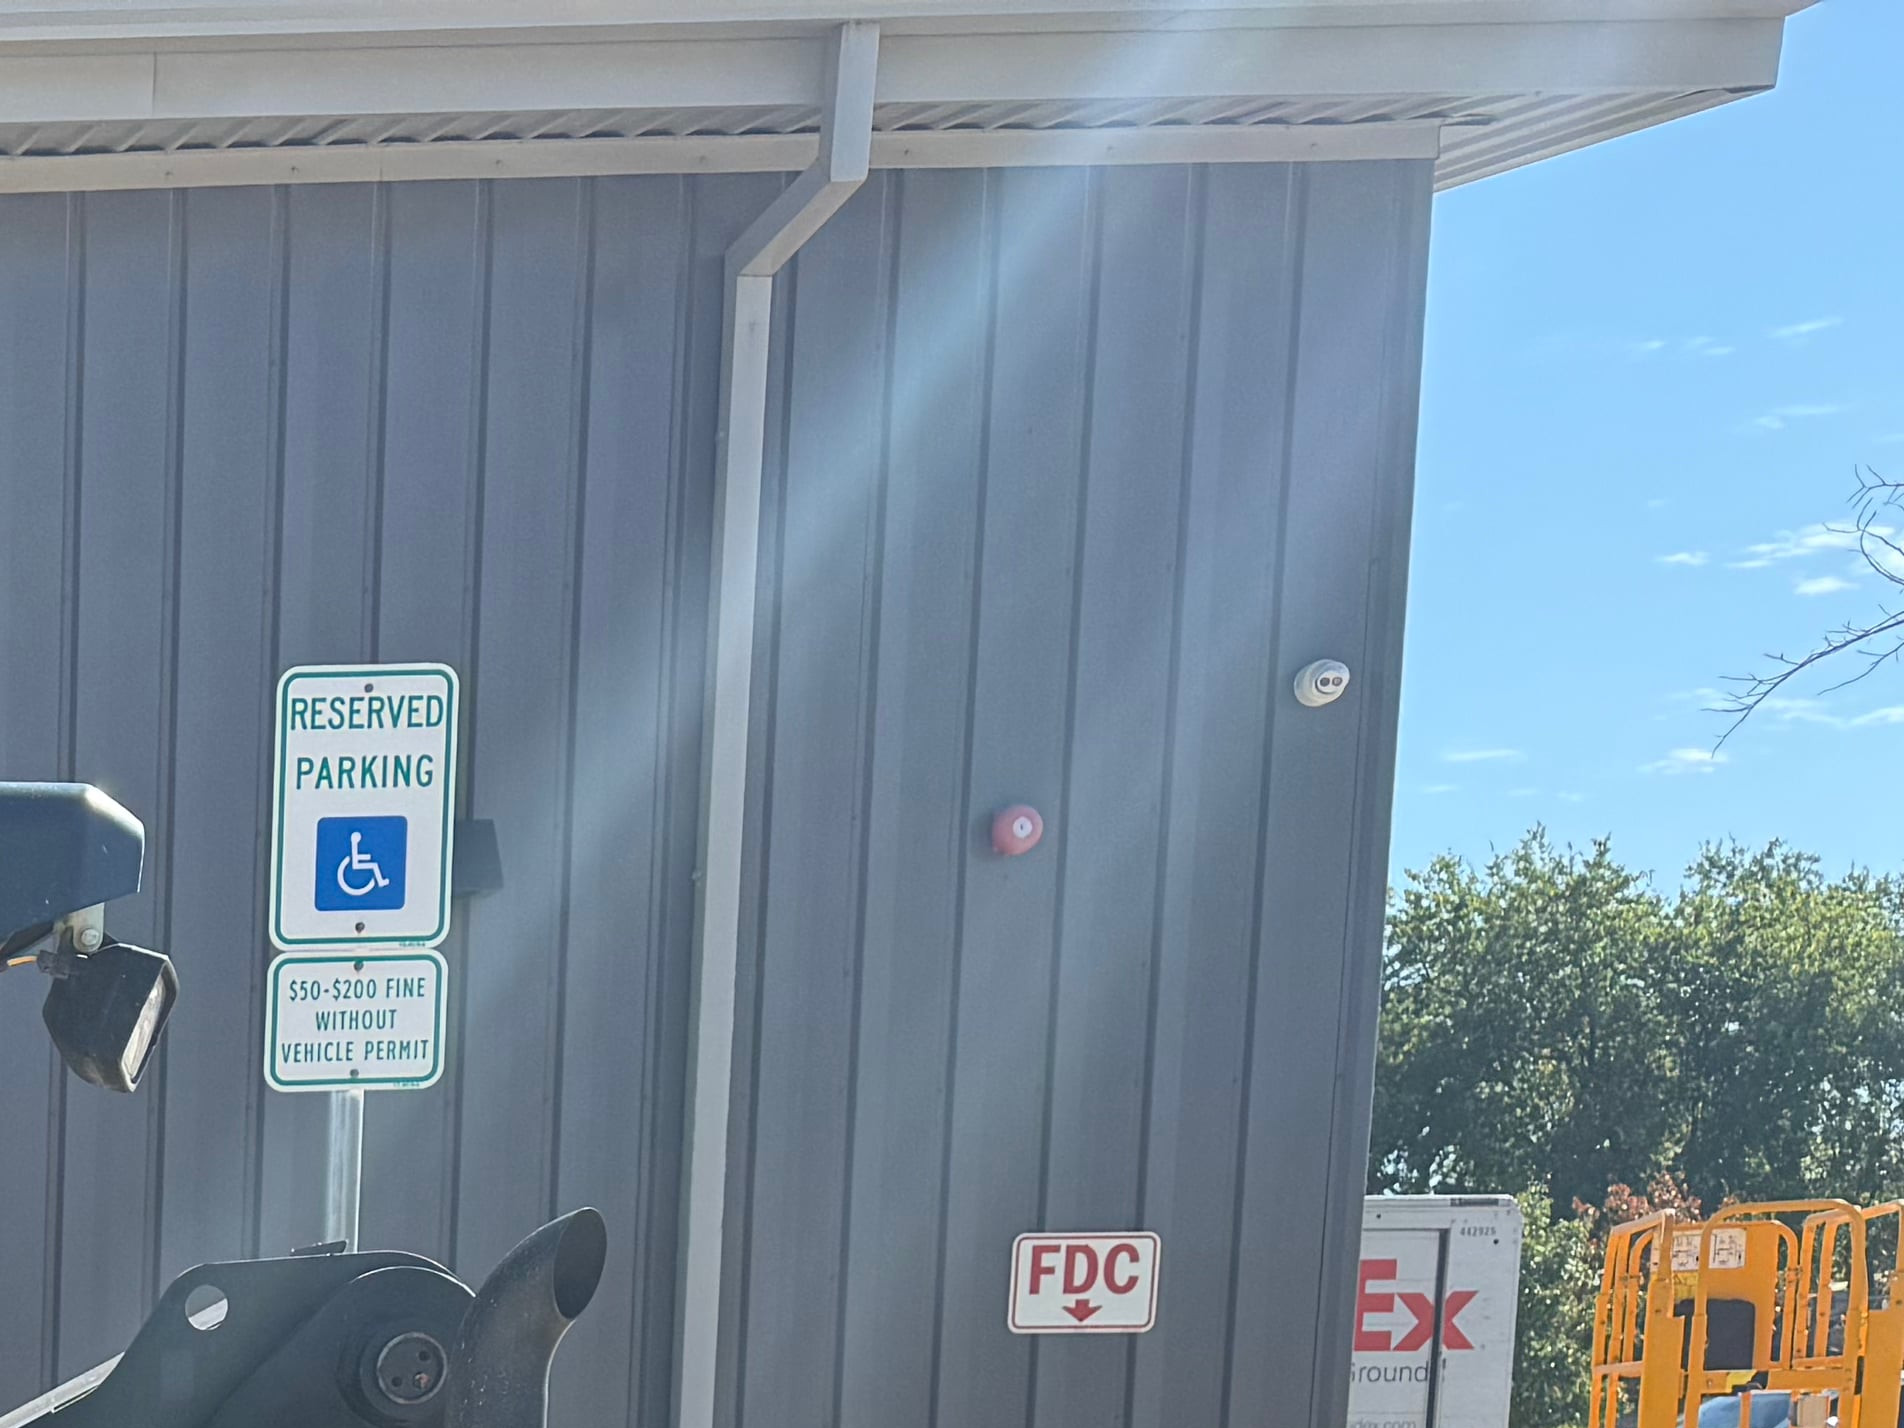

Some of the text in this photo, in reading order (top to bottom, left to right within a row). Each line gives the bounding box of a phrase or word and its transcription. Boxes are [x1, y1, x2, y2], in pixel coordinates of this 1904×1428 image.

[291, 695, 443, 729] RESERVED
[296, 754, 433, 788] PARKING
[289, 977, 424, 1000] $50-$200 FINE
[315, 1008, 396, 1030] WITHOUT
[282, 1039, 428, 1062] VEHICLE PERMIT
[1029, 1243, 1140, 1295] FDC
[1354, 1258, 1479, 1352] Ex
